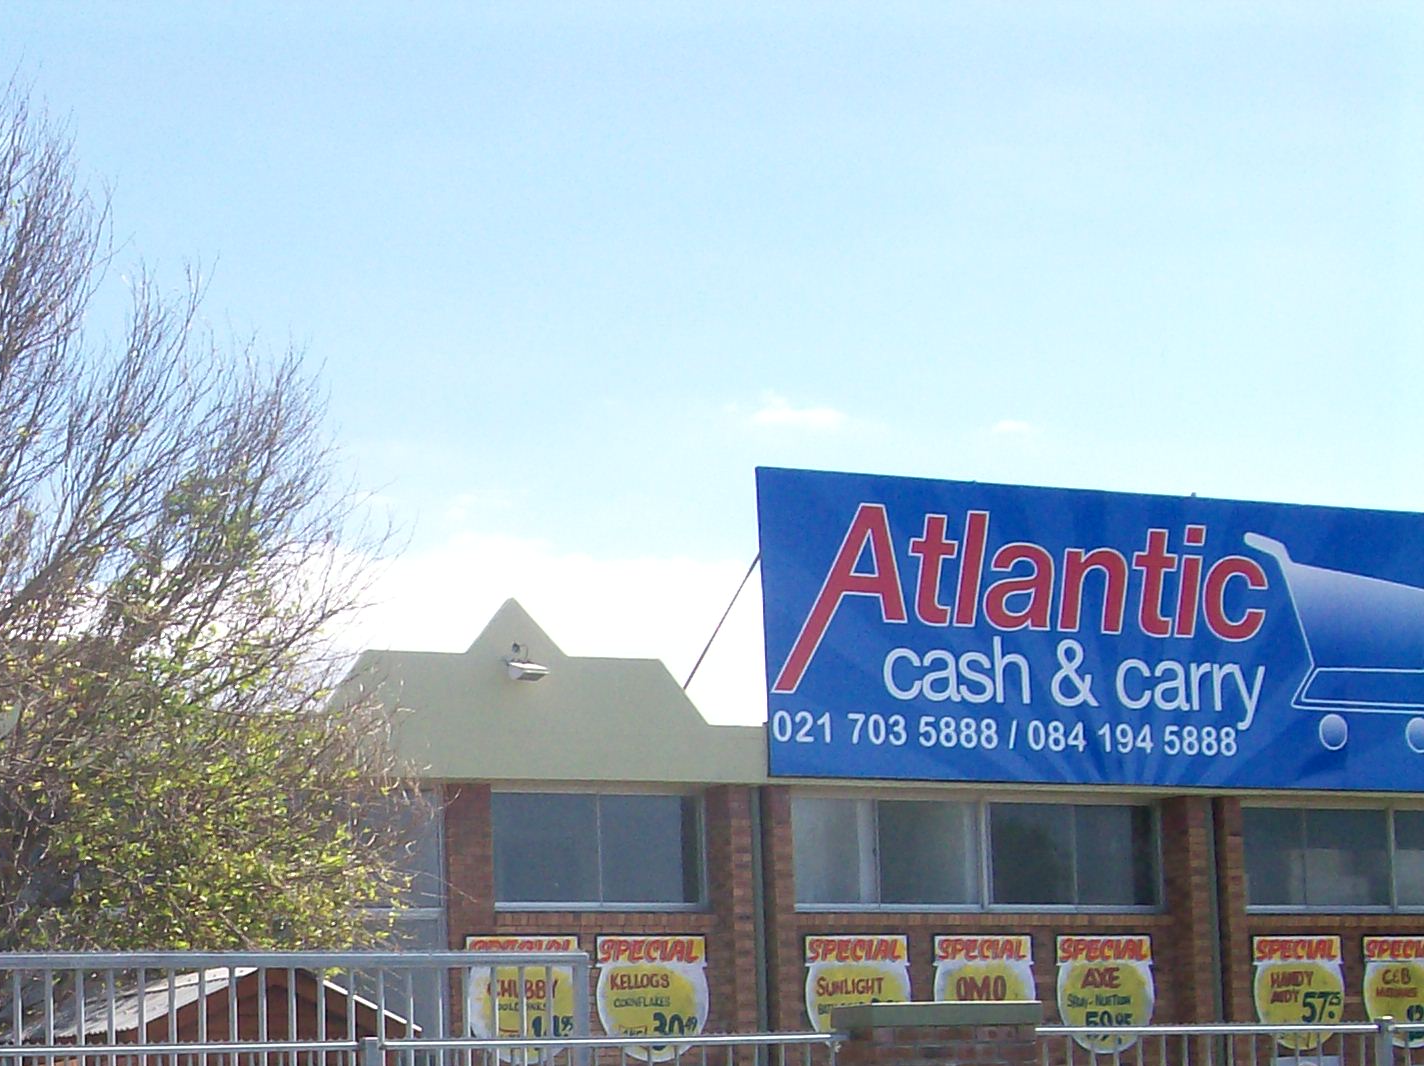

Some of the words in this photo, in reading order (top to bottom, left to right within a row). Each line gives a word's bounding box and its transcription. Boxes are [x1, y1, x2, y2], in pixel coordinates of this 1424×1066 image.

[772, 502, 1269, 694] Atlantic
[882, 636, 1031, 704] cash
[1050, 638, 1100, 708] &
[1115, 658, 1266, 731] carry
[771, 709, 832, 745] 021
[847, 712, 907, 748] 703
[918, 715, 999, 750] 5888
[1027, 719, 1087, 754] 084
[1097, 722, 1153, 756] 194
[1163, 722, 1238, 758] 5888
[598, 938, 701, 963] SPECIAL
[807, 938, 902, 962] SPECIAL
[937, 938, 1027, 961] SPECIAL
[1058, 937, 1147, 962] SPECIAL
[1256, 938, 1339, 960] SPECIAL
[609, 973, 671, 991] KELLOGS
[956, 975, 1007, 1001] OMO
[1080, 967, 1122, 989] AXE
